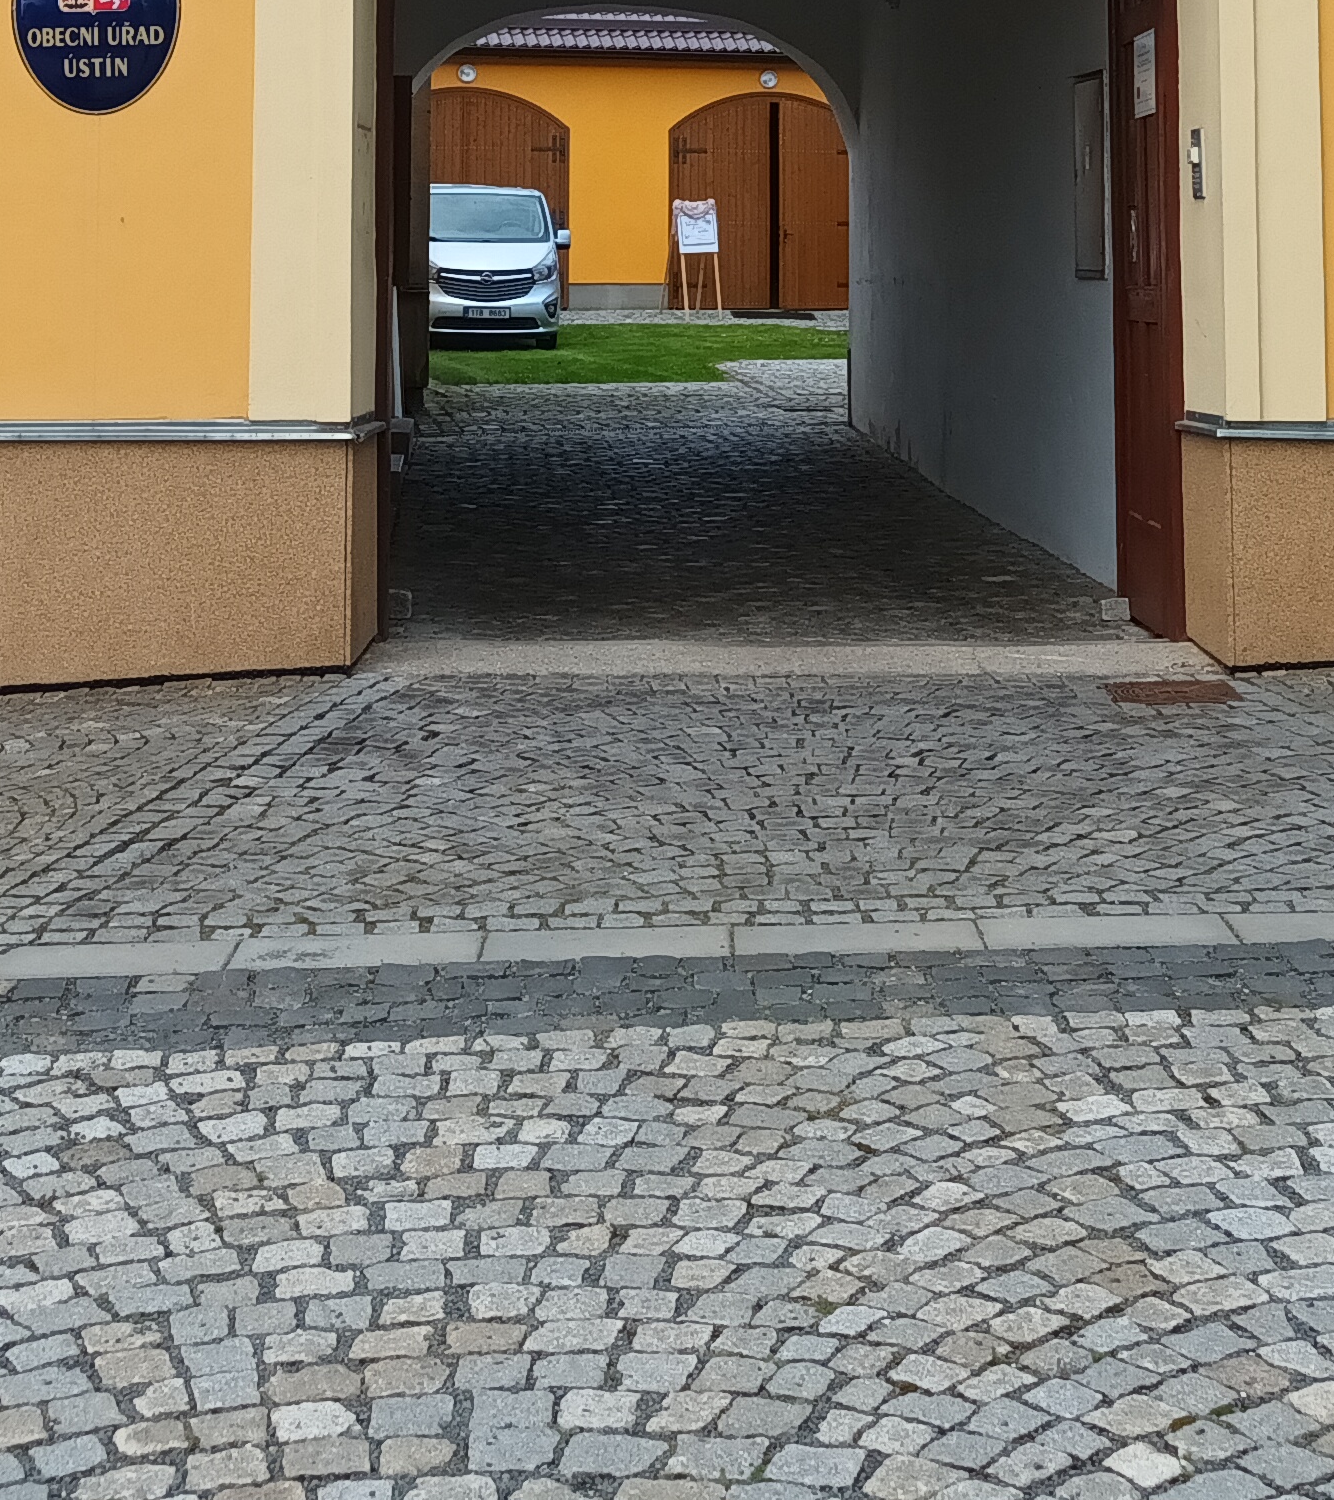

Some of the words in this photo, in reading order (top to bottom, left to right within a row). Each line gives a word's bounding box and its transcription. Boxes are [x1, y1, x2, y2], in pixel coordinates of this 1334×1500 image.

[26, 21, 100, 48] OBECNÍ
[106, 21, 165, 46] ÚŘAD
[63, 52, 128, 78] ÚSTÍN
